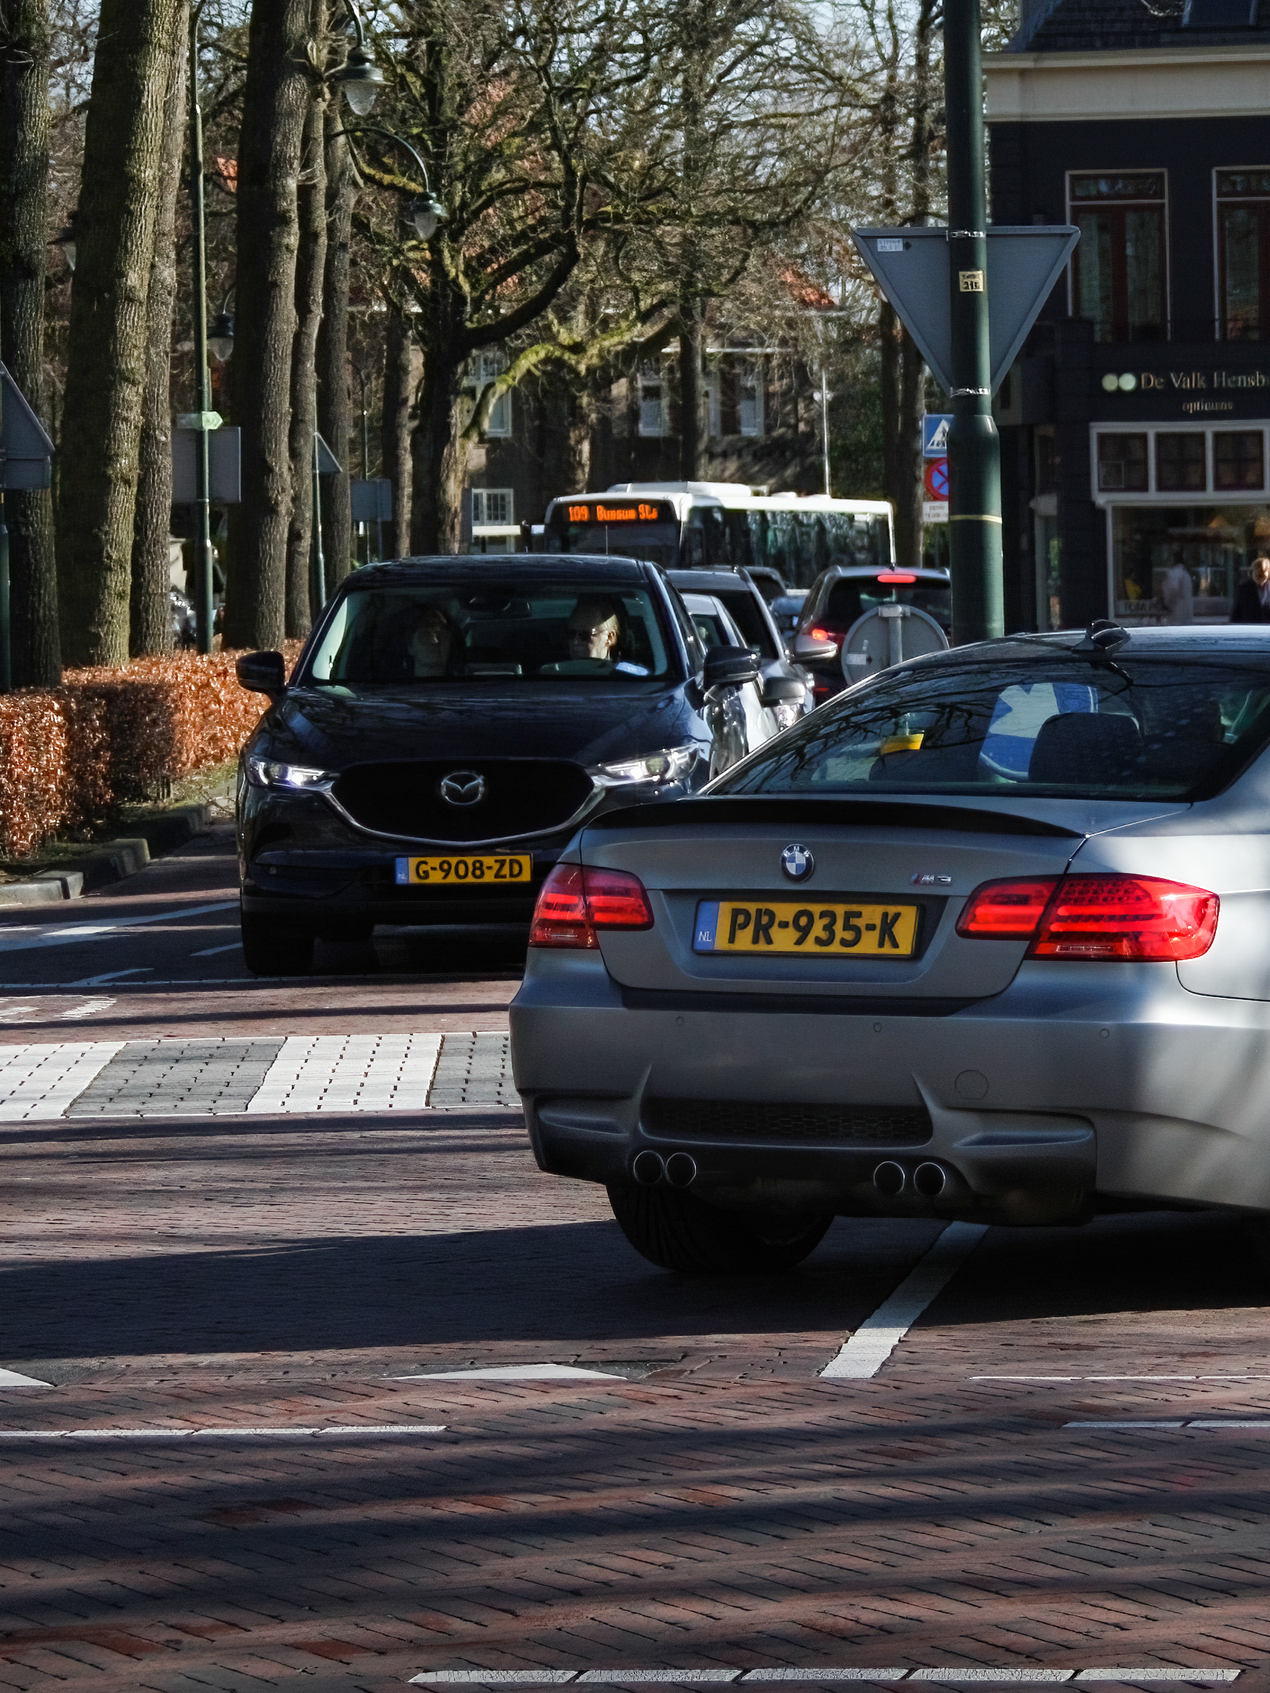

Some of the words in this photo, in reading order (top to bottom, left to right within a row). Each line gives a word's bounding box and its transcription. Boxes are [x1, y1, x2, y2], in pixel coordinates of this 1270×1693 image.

[1140, 372, 1165, 389] De
[1170, 371, 1206, 389] Valk
[415, 858, 523, 881] G-908-ZD
[698, 930, 713, 942] NL
[727, 907, 902, 949] PR-935-K
